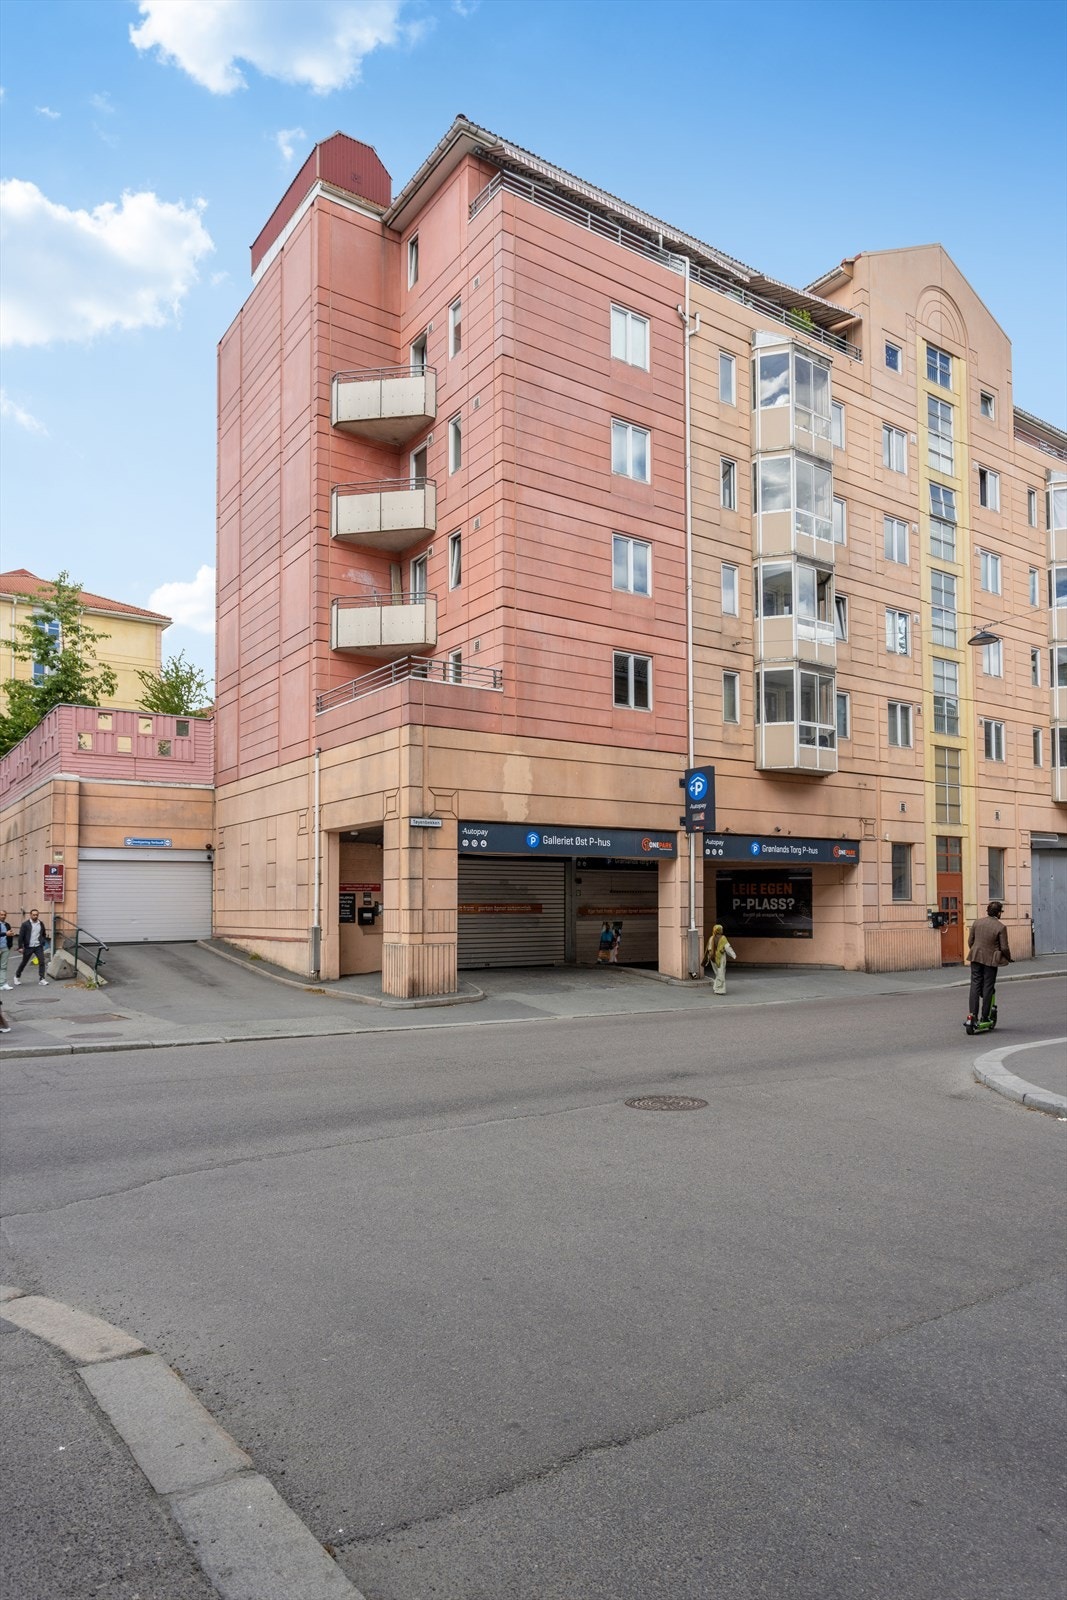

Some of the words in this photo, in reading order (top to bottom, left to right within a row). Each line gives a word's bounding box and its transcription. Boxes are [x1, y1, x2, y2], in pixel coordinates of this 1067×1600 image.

[462, 827, 489, 836] Autopay
[542, 835, 574, 847] Galleriet
[575, 836, 588, 847] Øst
[589, 837, 611, 847] P-hus
[649, 841, 673, 849] ONEPARK
[705, 838, 725, 847] Autopay
[761, 844, 790, 854] Grønlands
[790, 845, 802, 856] Torg
[802, 846, 819, 855] P-hus
[732, 883, 757, 895] LEIE
[760, 882, 793, 895] EGEN
[732, 897, 796, 910] P-PLASS?
